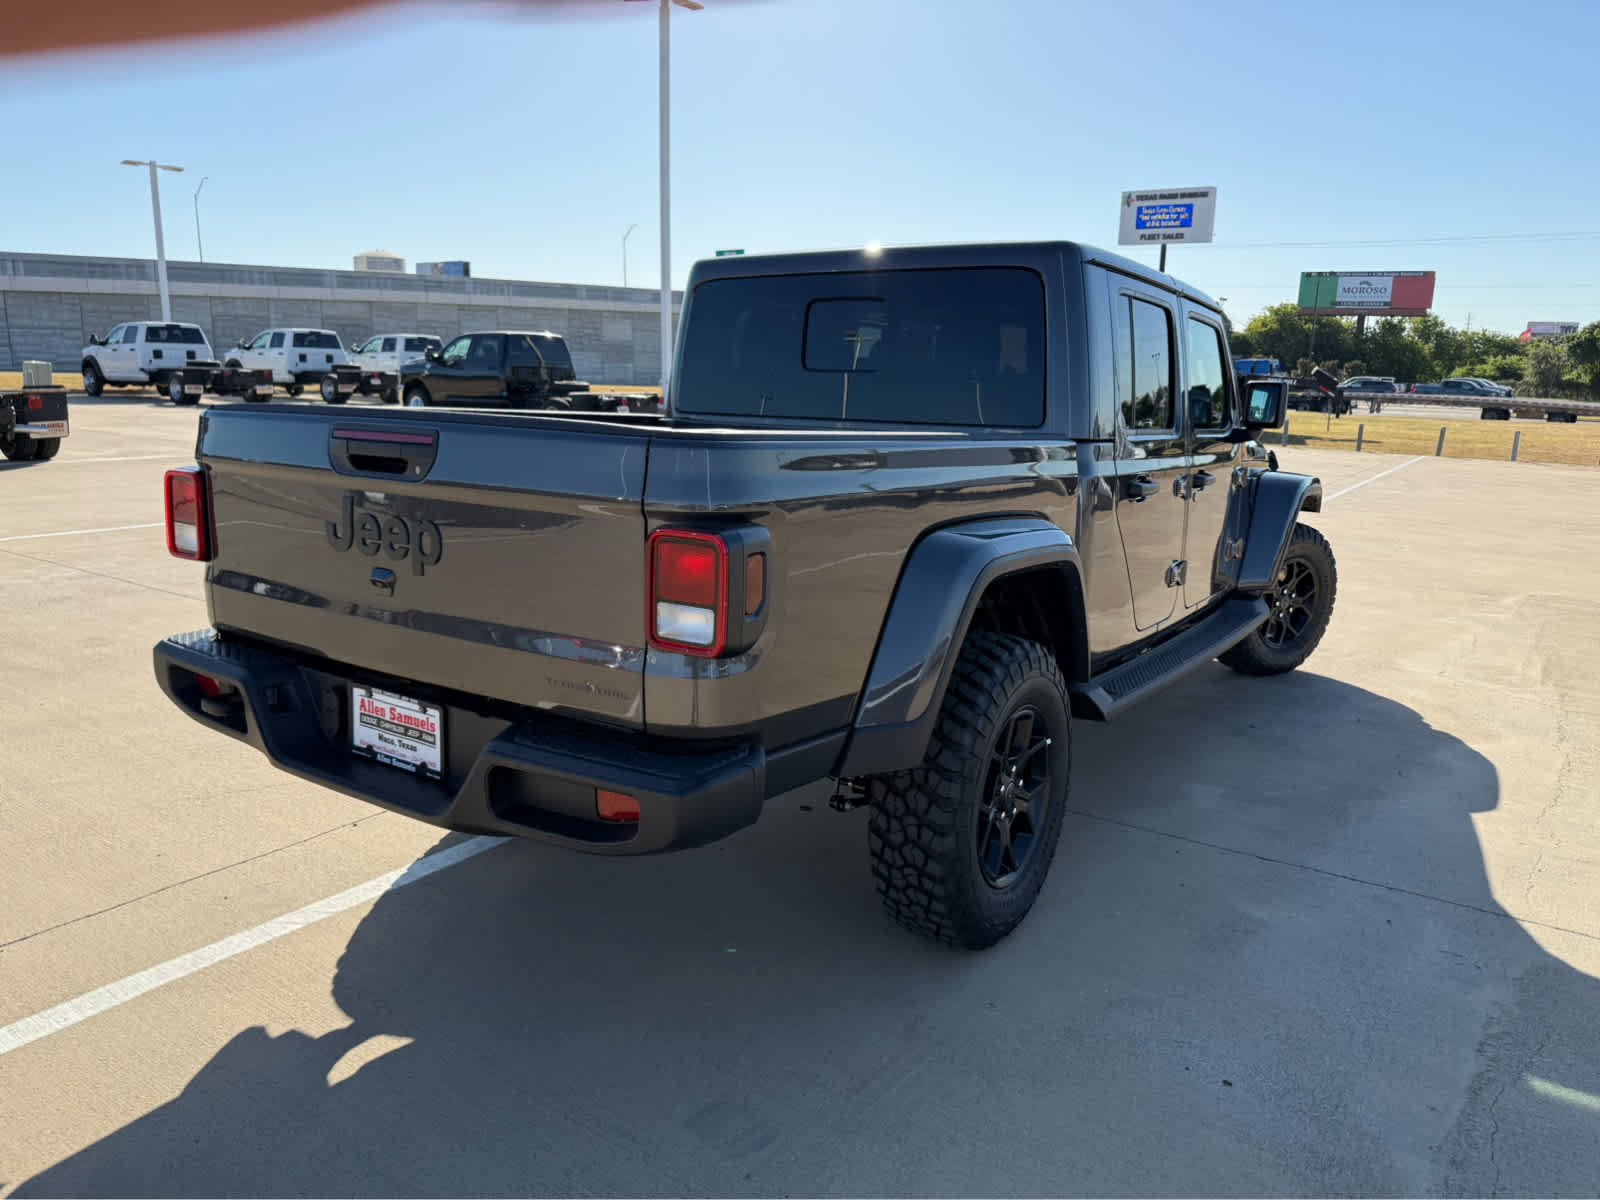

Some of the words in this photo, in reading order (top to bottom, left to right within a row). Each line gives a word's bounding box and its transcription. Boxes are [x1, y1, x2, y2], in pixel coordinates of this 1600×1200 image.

[1343, 287, 1388, 295] MOROSO
[326, 490, 443, 577] Jeep
[359, 698, 386, 717] Allen
[389, 707, 436, 732] Samuels
[378, 734, 397, 747] Waco,
[398, 740, 417, 752] Texas
